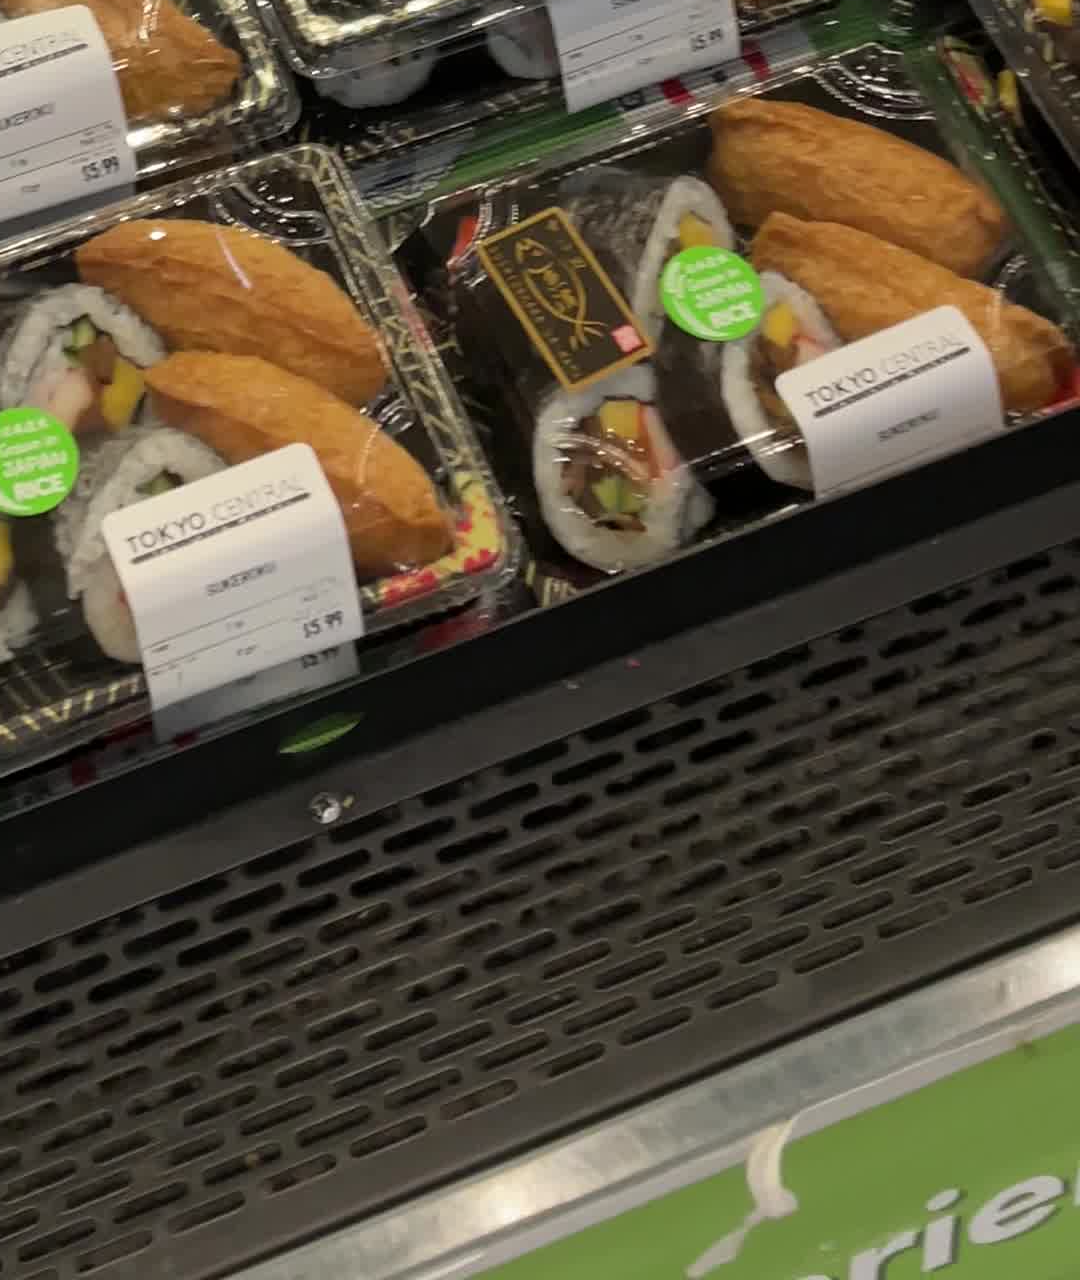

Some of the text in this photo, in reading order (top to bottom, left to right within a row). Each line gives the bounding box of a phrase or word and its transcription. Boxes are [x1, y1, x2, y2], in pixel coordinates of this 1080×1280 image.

[803, 334, 962, 407] TOKYO CENTRAL
[12, 471, 67, 502] RICE
[127, 474, 306, 554] TOKYO CENTRAL
